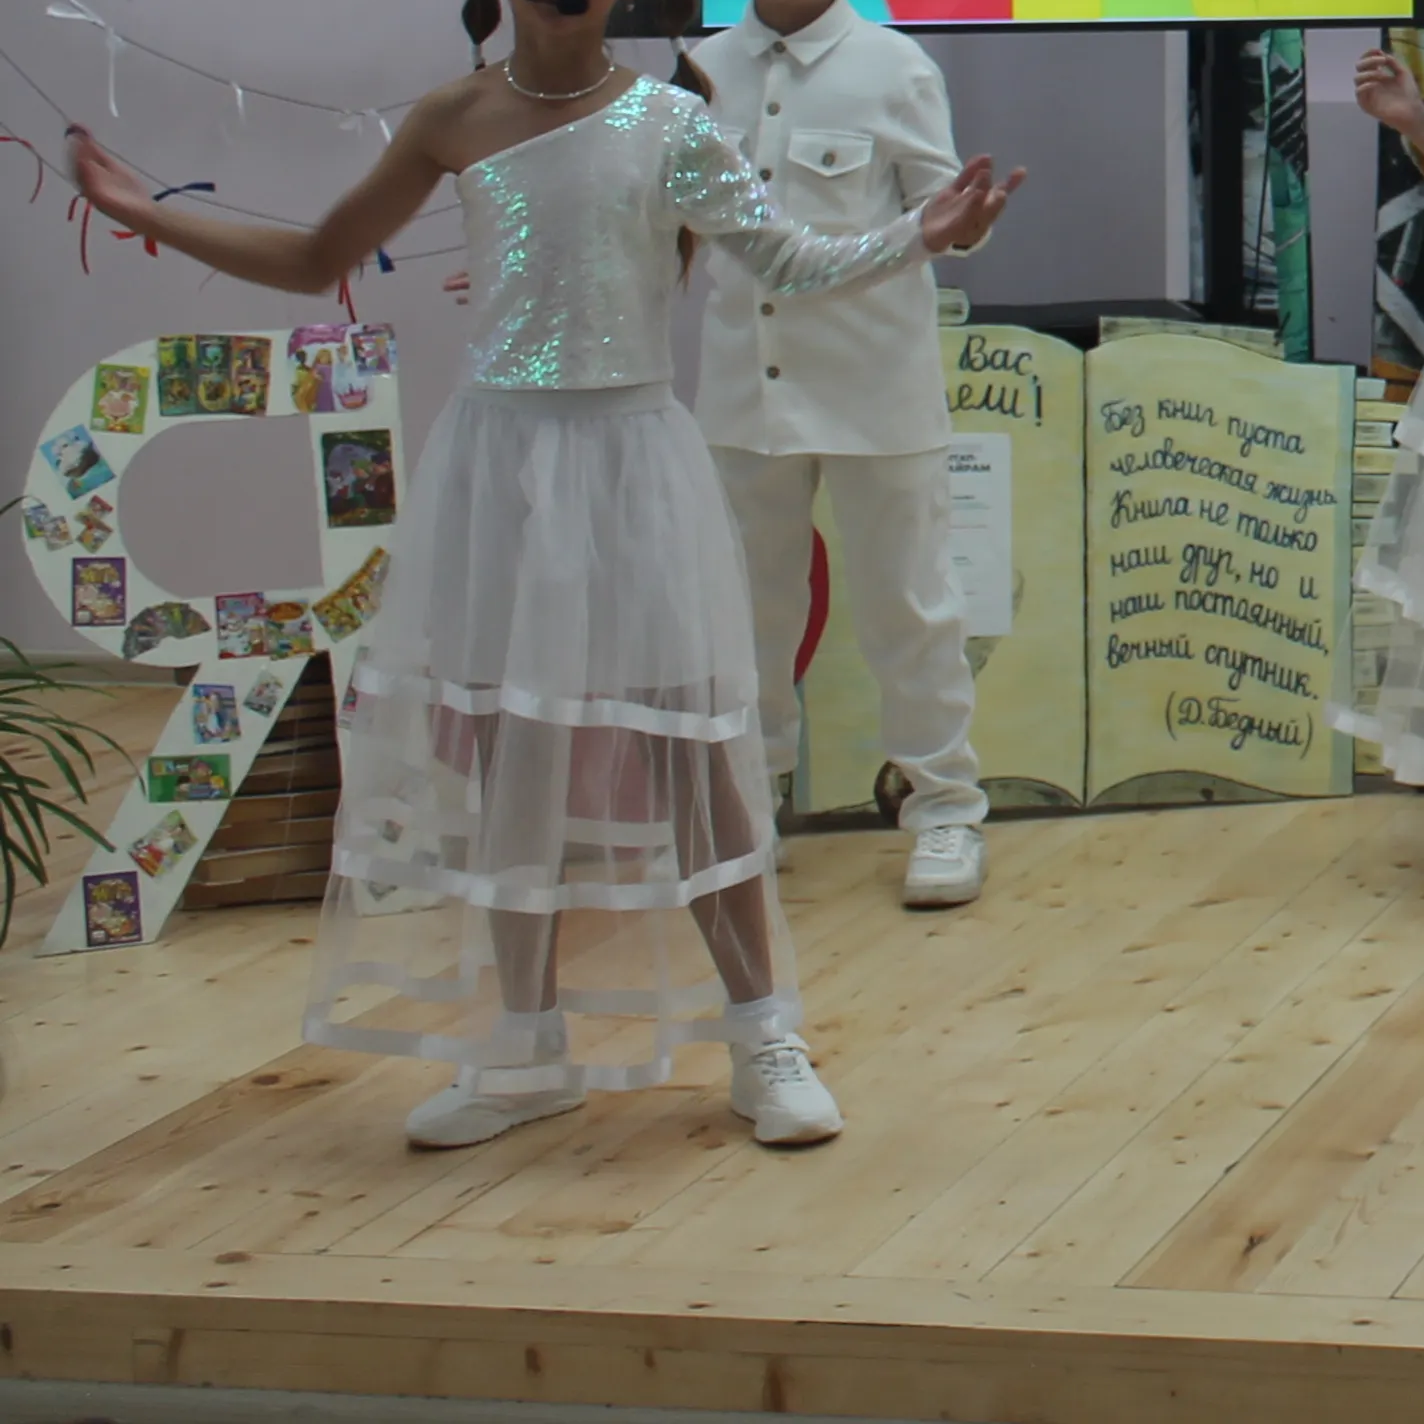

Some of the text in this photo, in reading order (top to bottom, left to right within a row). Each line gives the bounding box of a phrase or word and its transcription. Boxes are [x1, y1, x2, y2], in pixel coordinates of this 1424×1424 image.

[959, 333, 1038, 384] Вас,
[1101, 398, 1306, 458] Без книг пуста
[1110, 437, 1260, 495] человеческая
[1111, 488, 1318, 552] Книга не только
[1110, 543, 1319, 601] наш друг, но и
[1110, 588, 1329, 656] наш постоянный,
[1106, 633, 1319, 701] вечный спутник.
